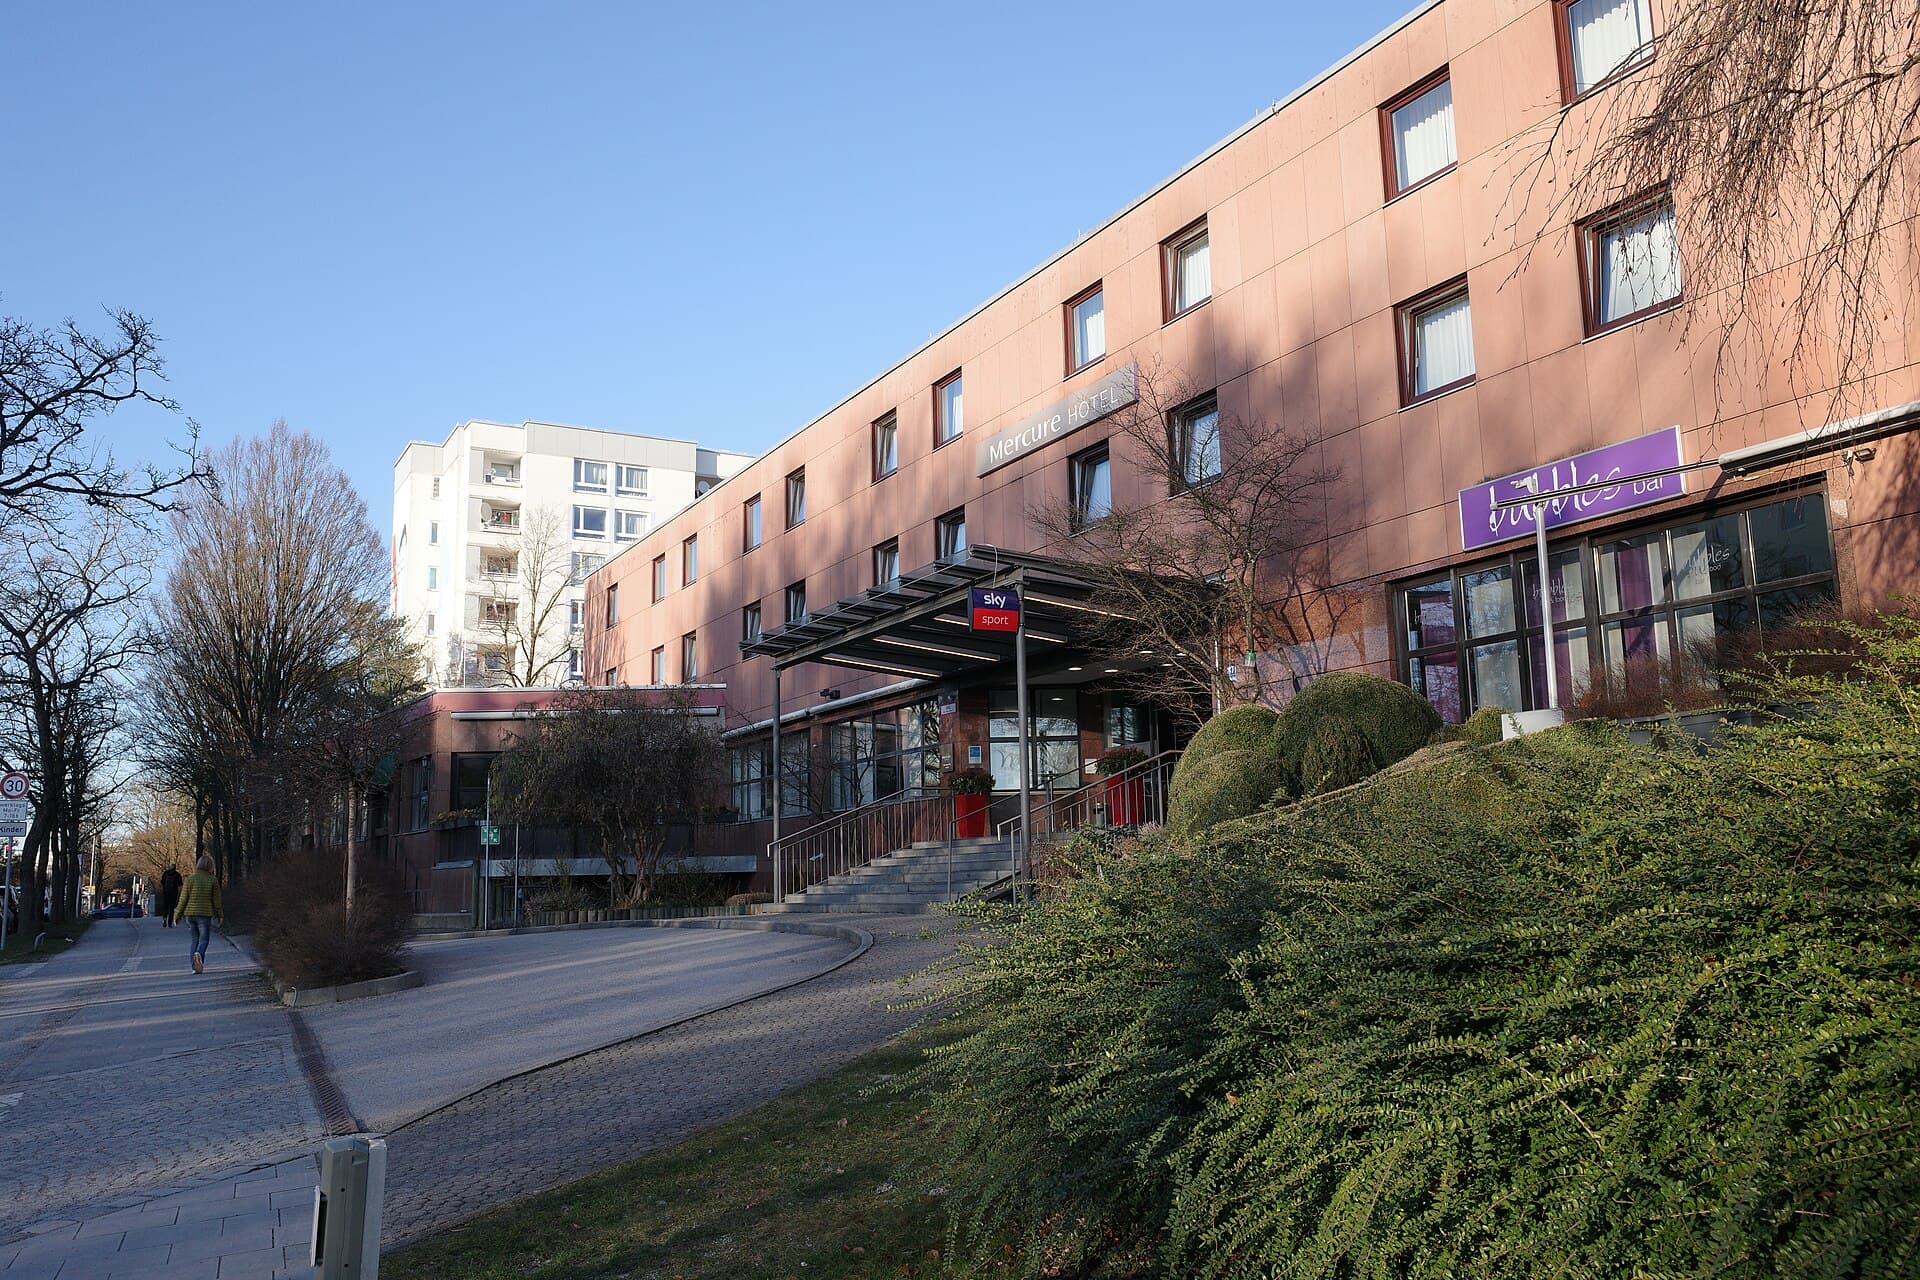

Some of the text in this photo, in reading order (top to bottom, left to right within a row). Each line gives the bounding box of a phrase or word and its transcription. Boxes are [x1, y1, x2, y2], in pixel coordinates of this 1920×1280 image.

[989, 386, 1118, 464] Mercure HOTEL
[1632, 473, 1664, 496] bar
[983, 592, 1006, 609] sky
[982, 615, 1009, 625] sport
[6, 780, 23, 792] 30
